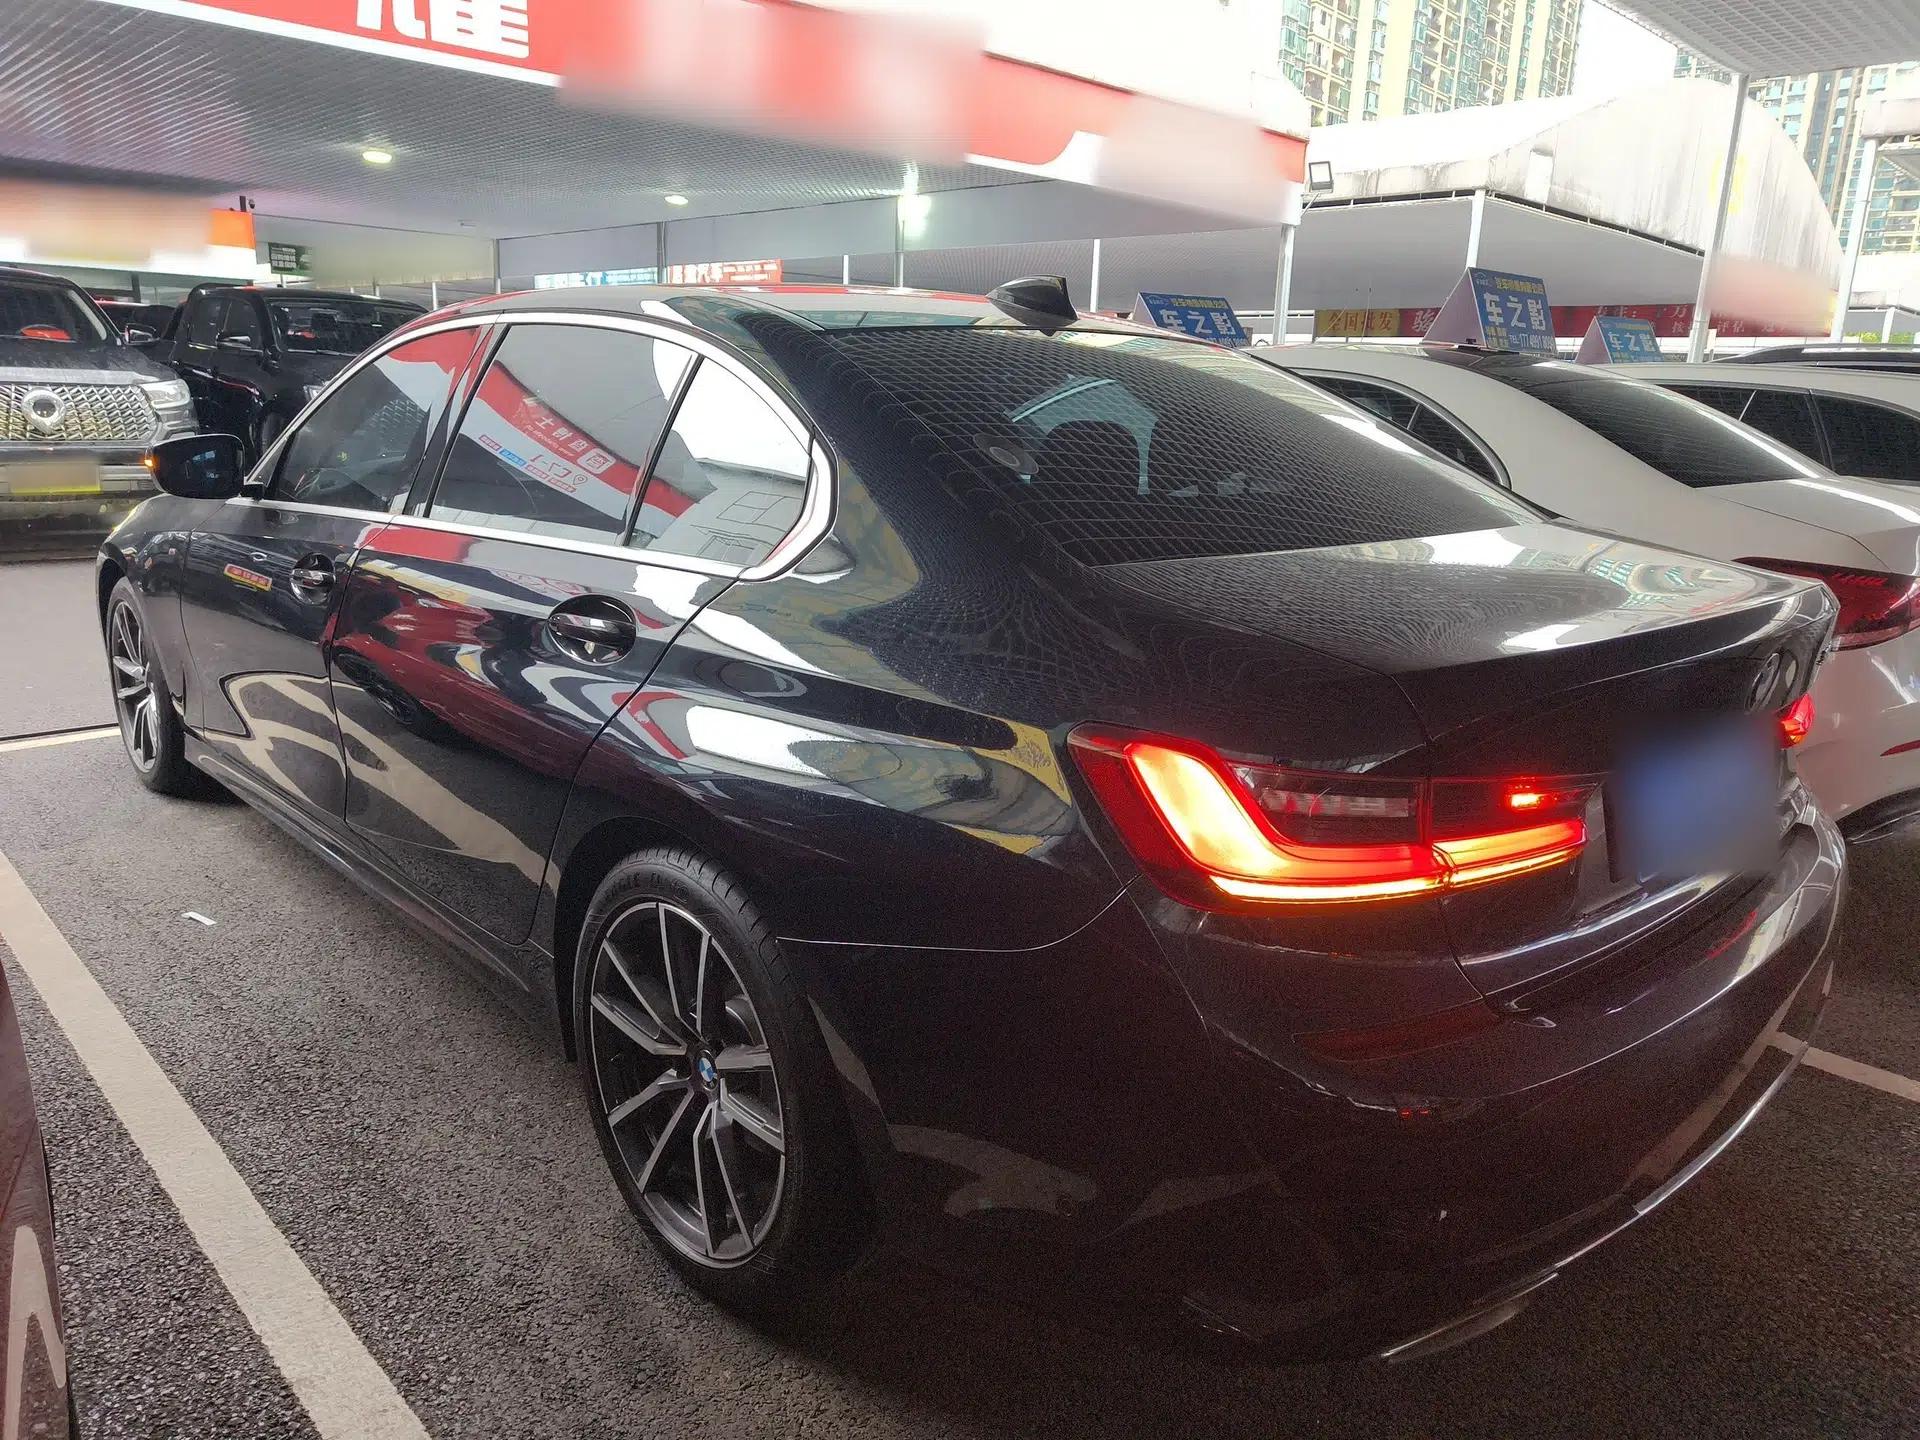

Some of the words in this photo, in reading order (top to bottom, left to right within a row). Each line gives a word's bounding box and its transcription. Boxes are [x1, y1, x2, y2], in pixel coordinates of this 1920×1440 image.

[1160, 308, 1235, 335] 车之影
[1328, 311, 1393, 332] 全国批发
[1483, 292, 1546, 331] 车之影
[1608, 331, 1657, 353] 车之影
